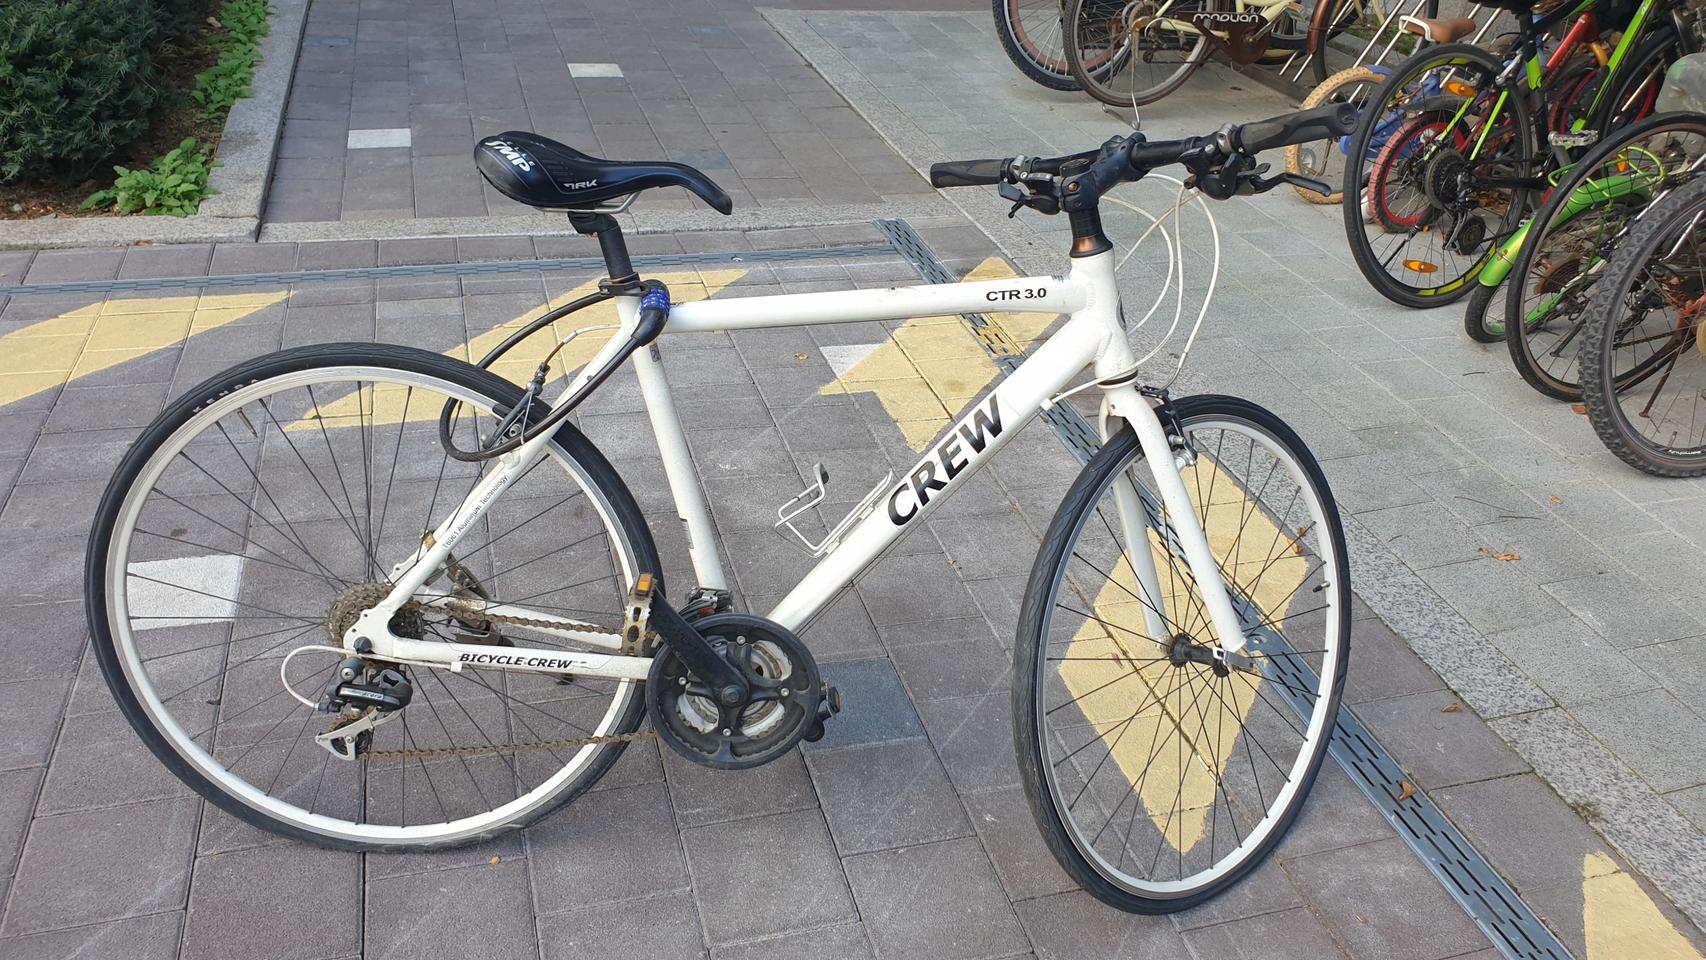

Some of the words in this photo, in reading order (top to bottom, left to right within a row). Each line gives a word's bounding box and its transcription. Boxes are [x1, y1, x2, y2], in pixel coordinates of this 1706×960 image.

[485, 140, 531, 172] SMP
[986, 290, 1021, 302] CTR
[1024, 287, 1047, 300] 3.0
[887, 394, 1004, 527] CREW
[479, 475, 509, 506] Technology
[459, 653, 525, 666] BICYCLE
[527, 656, 573, 669] CREW
